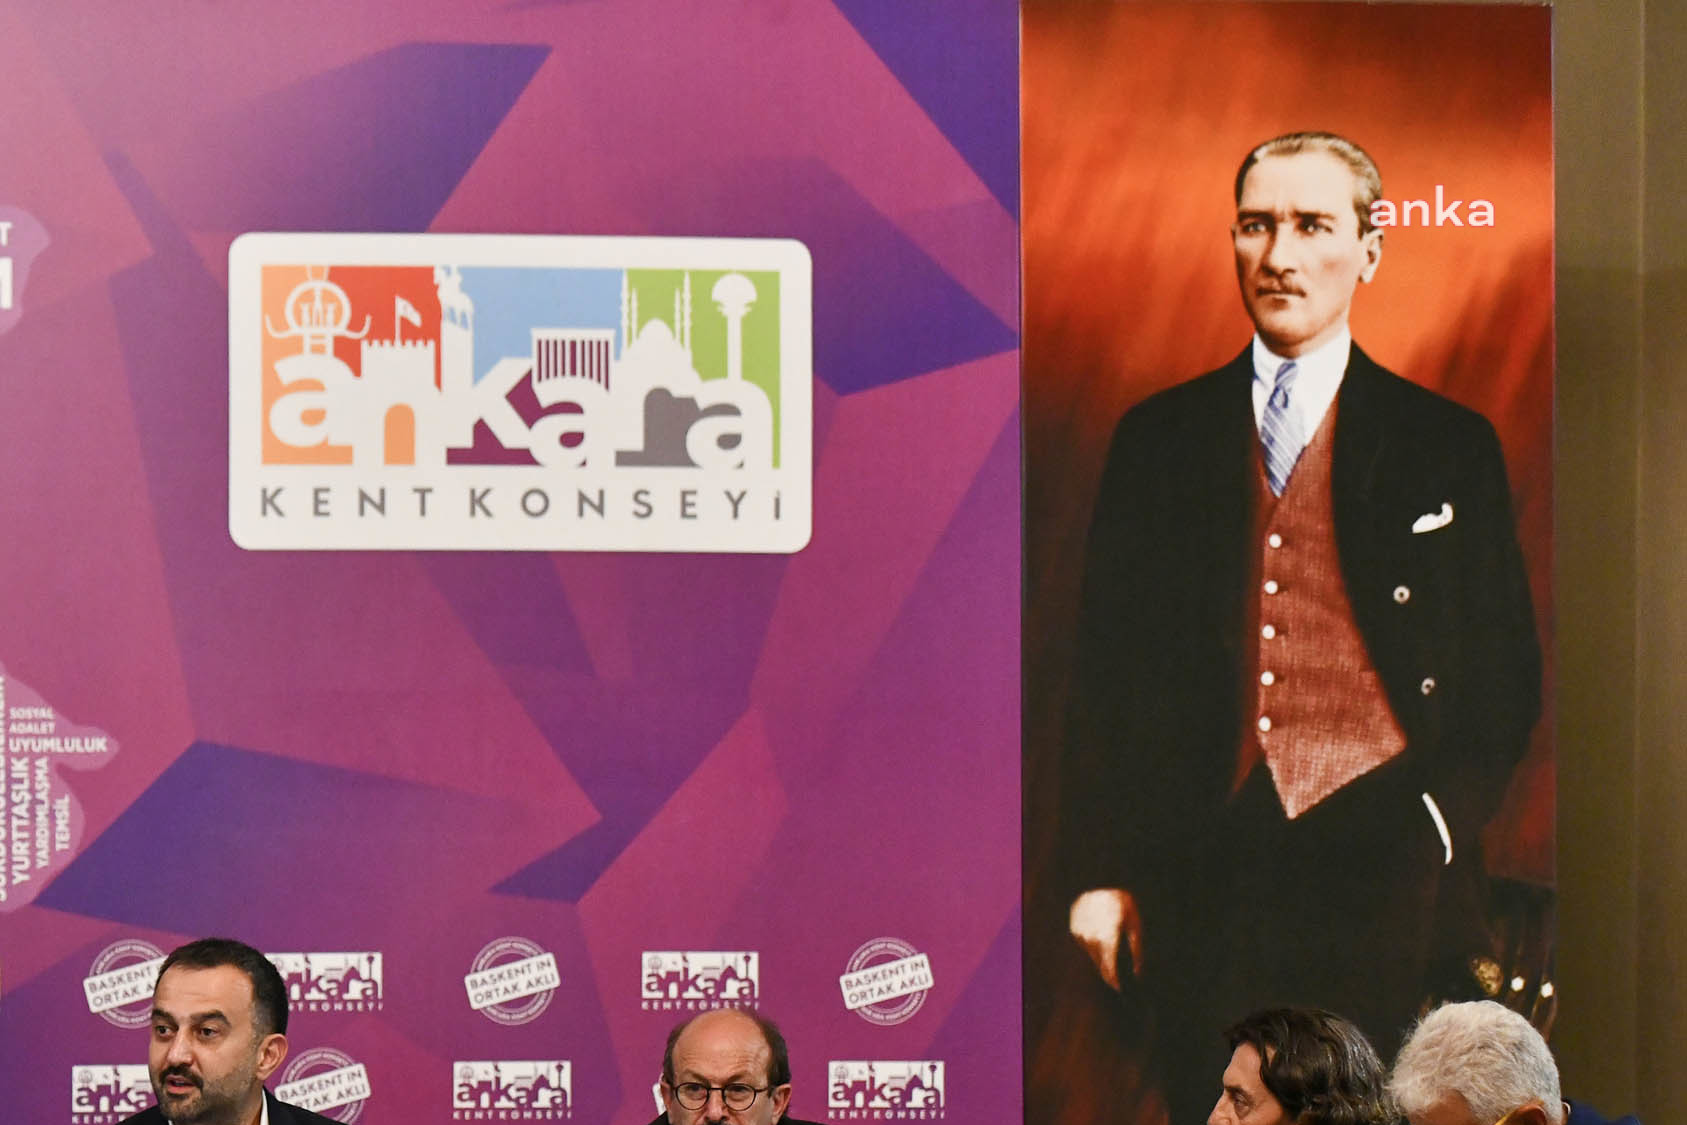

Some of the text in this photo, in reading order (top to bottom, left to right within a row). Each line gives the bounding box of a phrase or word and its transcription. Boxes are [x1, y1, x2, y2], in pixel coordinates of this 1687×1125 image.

[267, 325, 776, 468] ankara
[260, 487, 782, 521] KENT KONSEYİ
[9, 736, 107, 752] UYUMLULUK
[11, 757, 32, 885] YURTTAŞLIK
[285, 962, 380, 1000] nkara
[74, 1076, 155, 1113] anka
